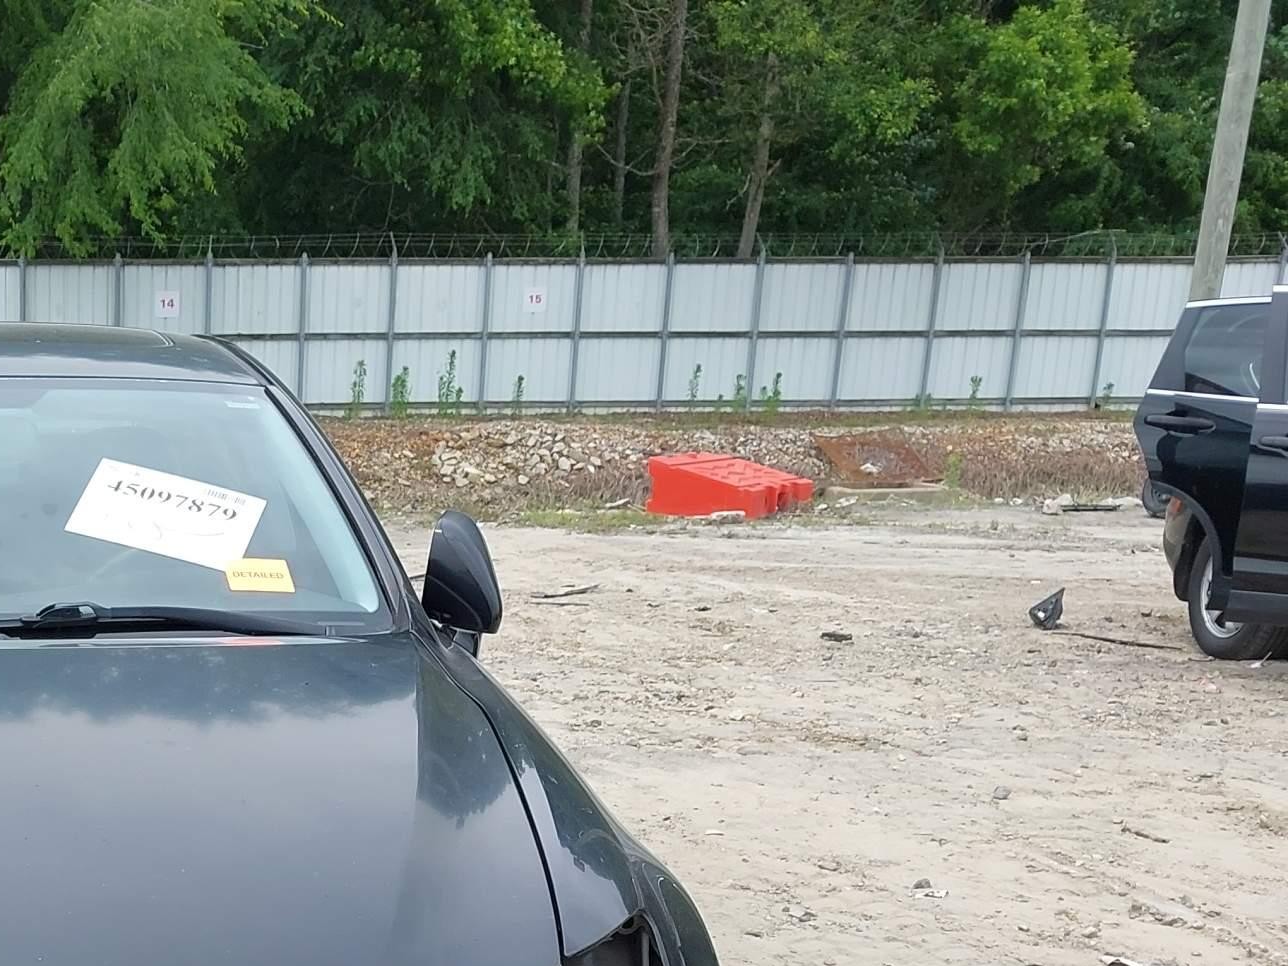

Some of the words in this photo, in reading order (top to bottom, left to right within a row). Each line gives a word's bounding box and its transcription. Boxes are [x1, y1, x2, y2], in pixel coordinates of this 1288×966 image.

[159, 298, 174, 309] 14
[528, 294, 542, 304] 15
[107, 480, 237, 521] 45097879
[232, 570, 285, 580] DETAILED
